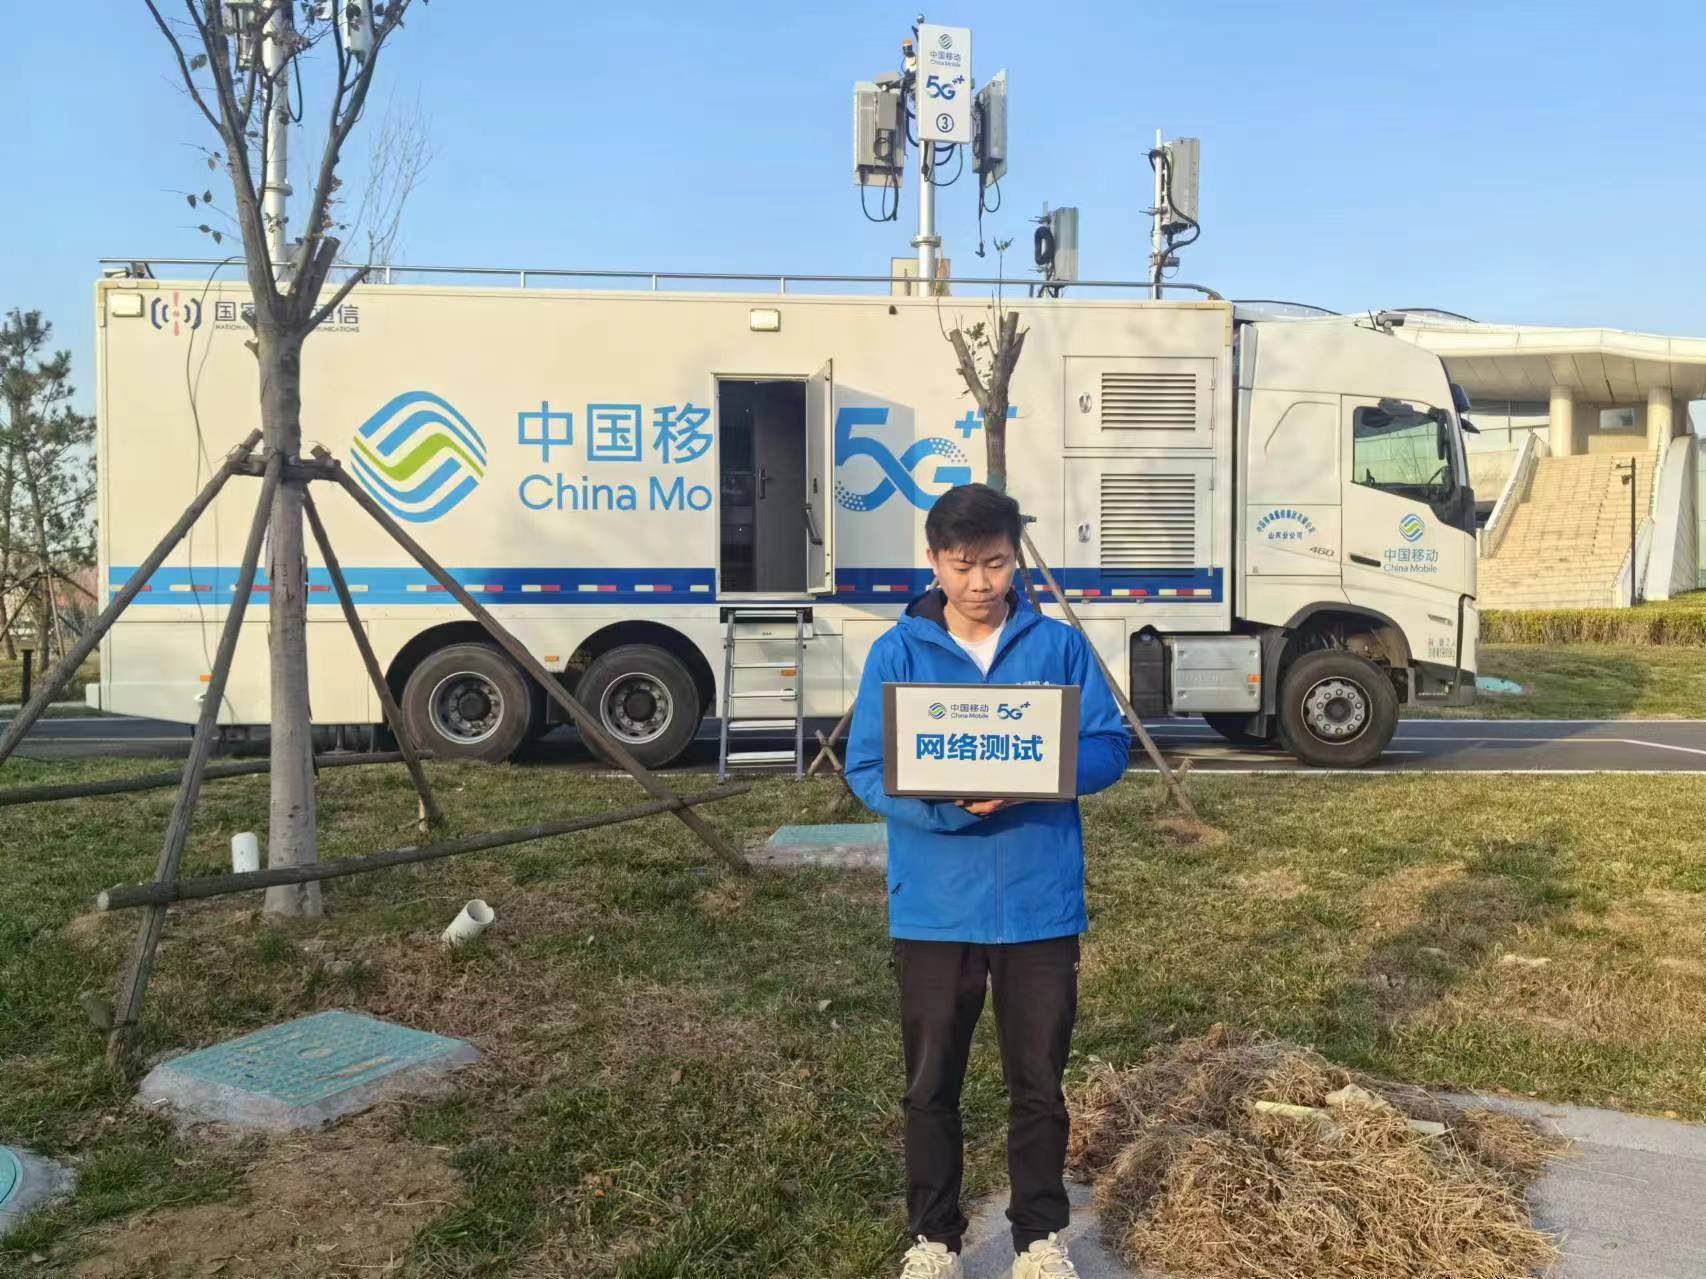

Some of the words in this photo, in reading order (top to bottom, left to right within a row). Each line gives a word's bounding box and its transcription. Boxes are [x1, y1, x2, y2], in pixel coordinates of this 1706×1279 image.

[518, 472, 637, 510] China
[648, 476, 713, 511] Mo
[1309, 546, 1336, 558] 460
[1383, 548, 1440, 563] 中国移动
[1383, 563, 1409, 573] China
[1410, 564, 1438, 574] Mobile
[950, 703, 989, 713] 中国移动
[915, 732, 1044, 762] 网络测试
